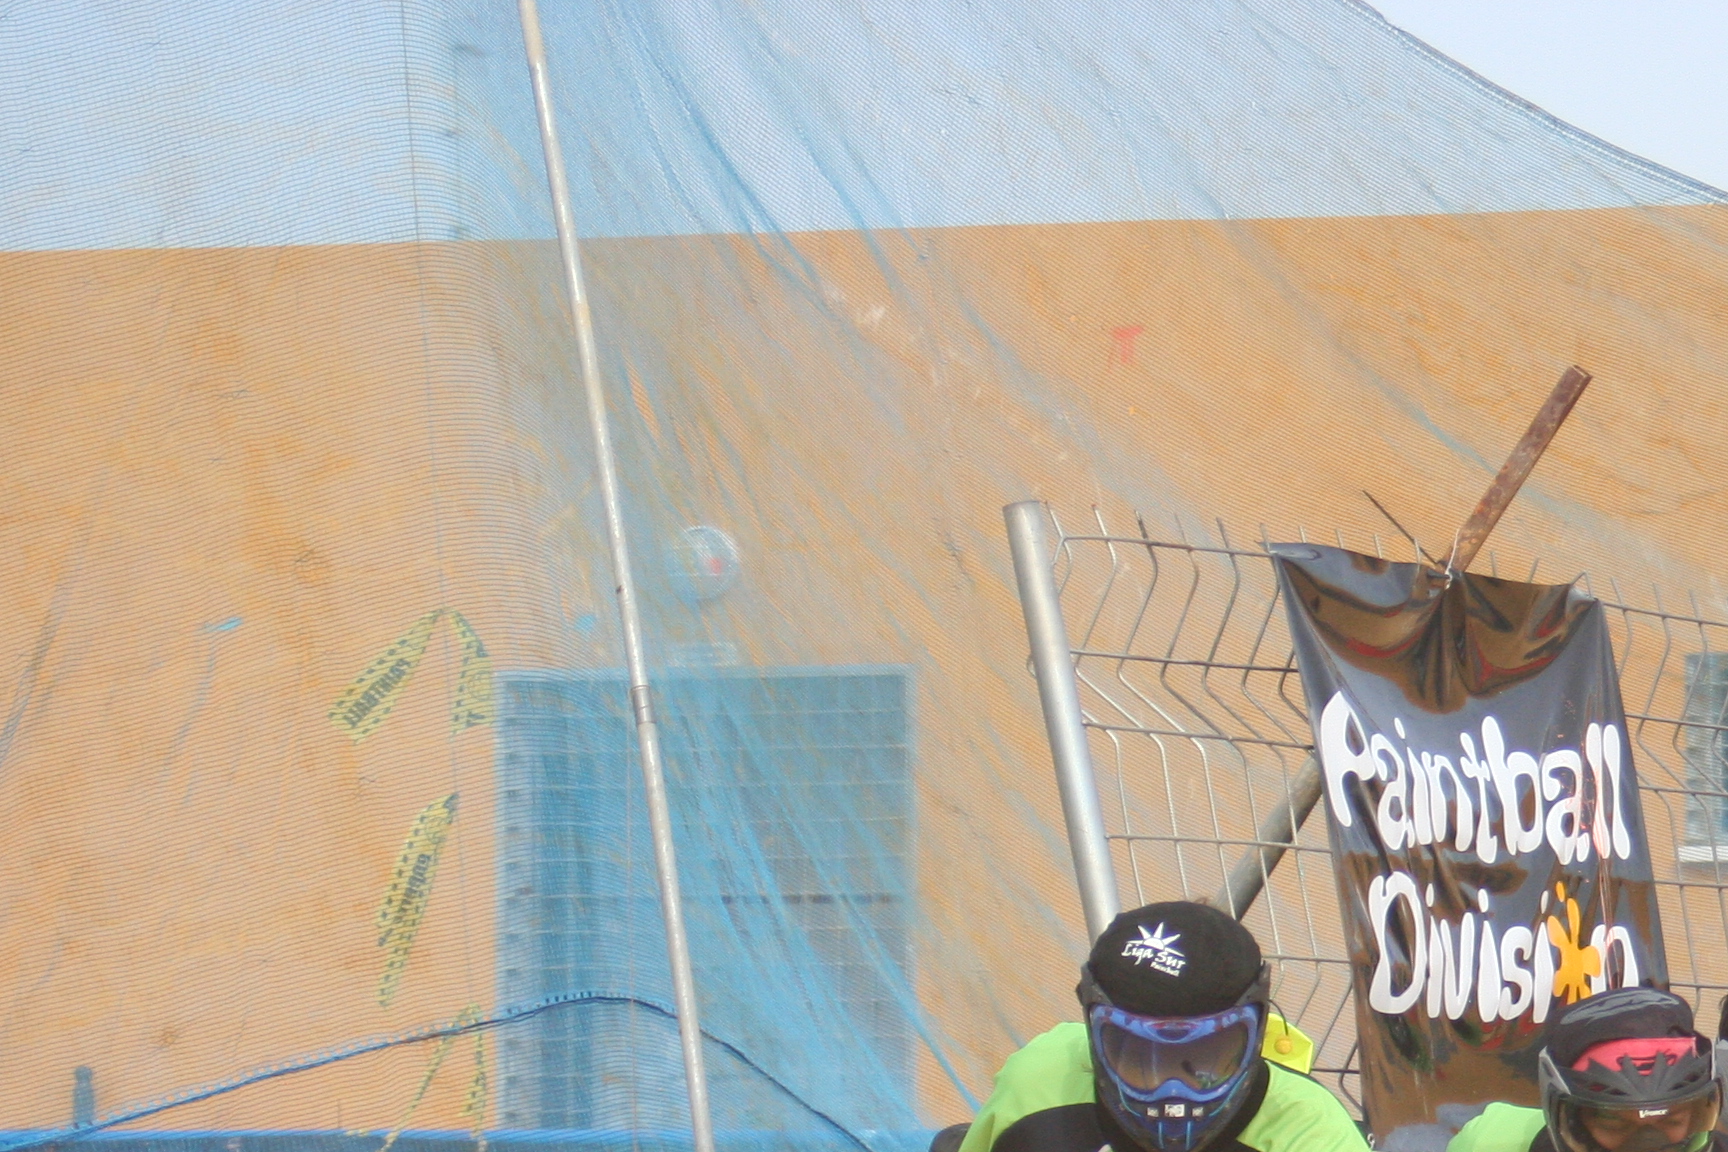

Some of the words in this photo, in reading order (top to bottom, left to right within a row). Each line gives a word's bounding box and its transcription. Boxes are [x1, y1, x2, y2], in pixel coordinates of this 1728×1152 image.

[1320, 690, 1631, 865] Paintball
[1121, 943, 1154, 965] Liga
[1154, 951, 1186, 969] Sur
